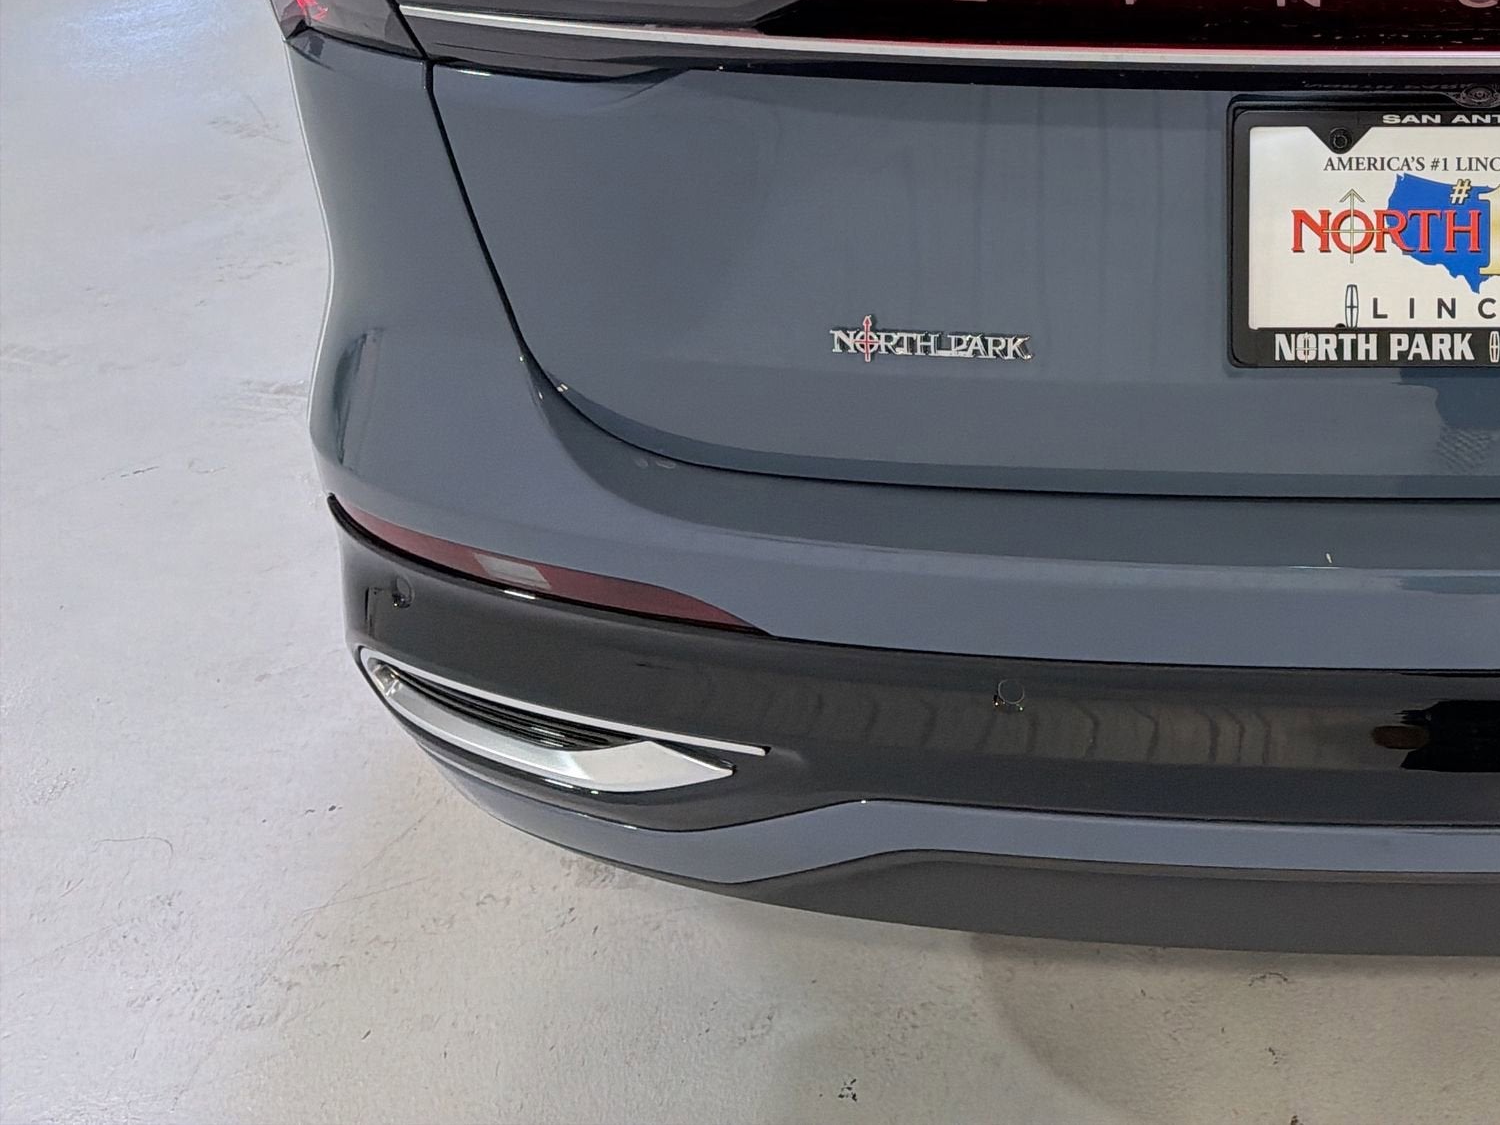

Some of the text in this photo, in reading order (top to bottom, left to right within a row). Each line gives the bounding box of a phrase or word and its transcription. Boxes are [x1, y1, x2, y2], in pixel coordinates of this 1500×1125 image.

[1382, 113, 1442, 125] SAN
[1323, 156, 1426, 173] AMERICA'S
[1430, 156, 1449, 172] #1
[1290, 209, 1482, 255] NORTH
[828, 329, 1034, 361] NORTH PARK
[1274, 332, 1378, 362] NORTH
[1389, 333, 1475, 361] PARK
